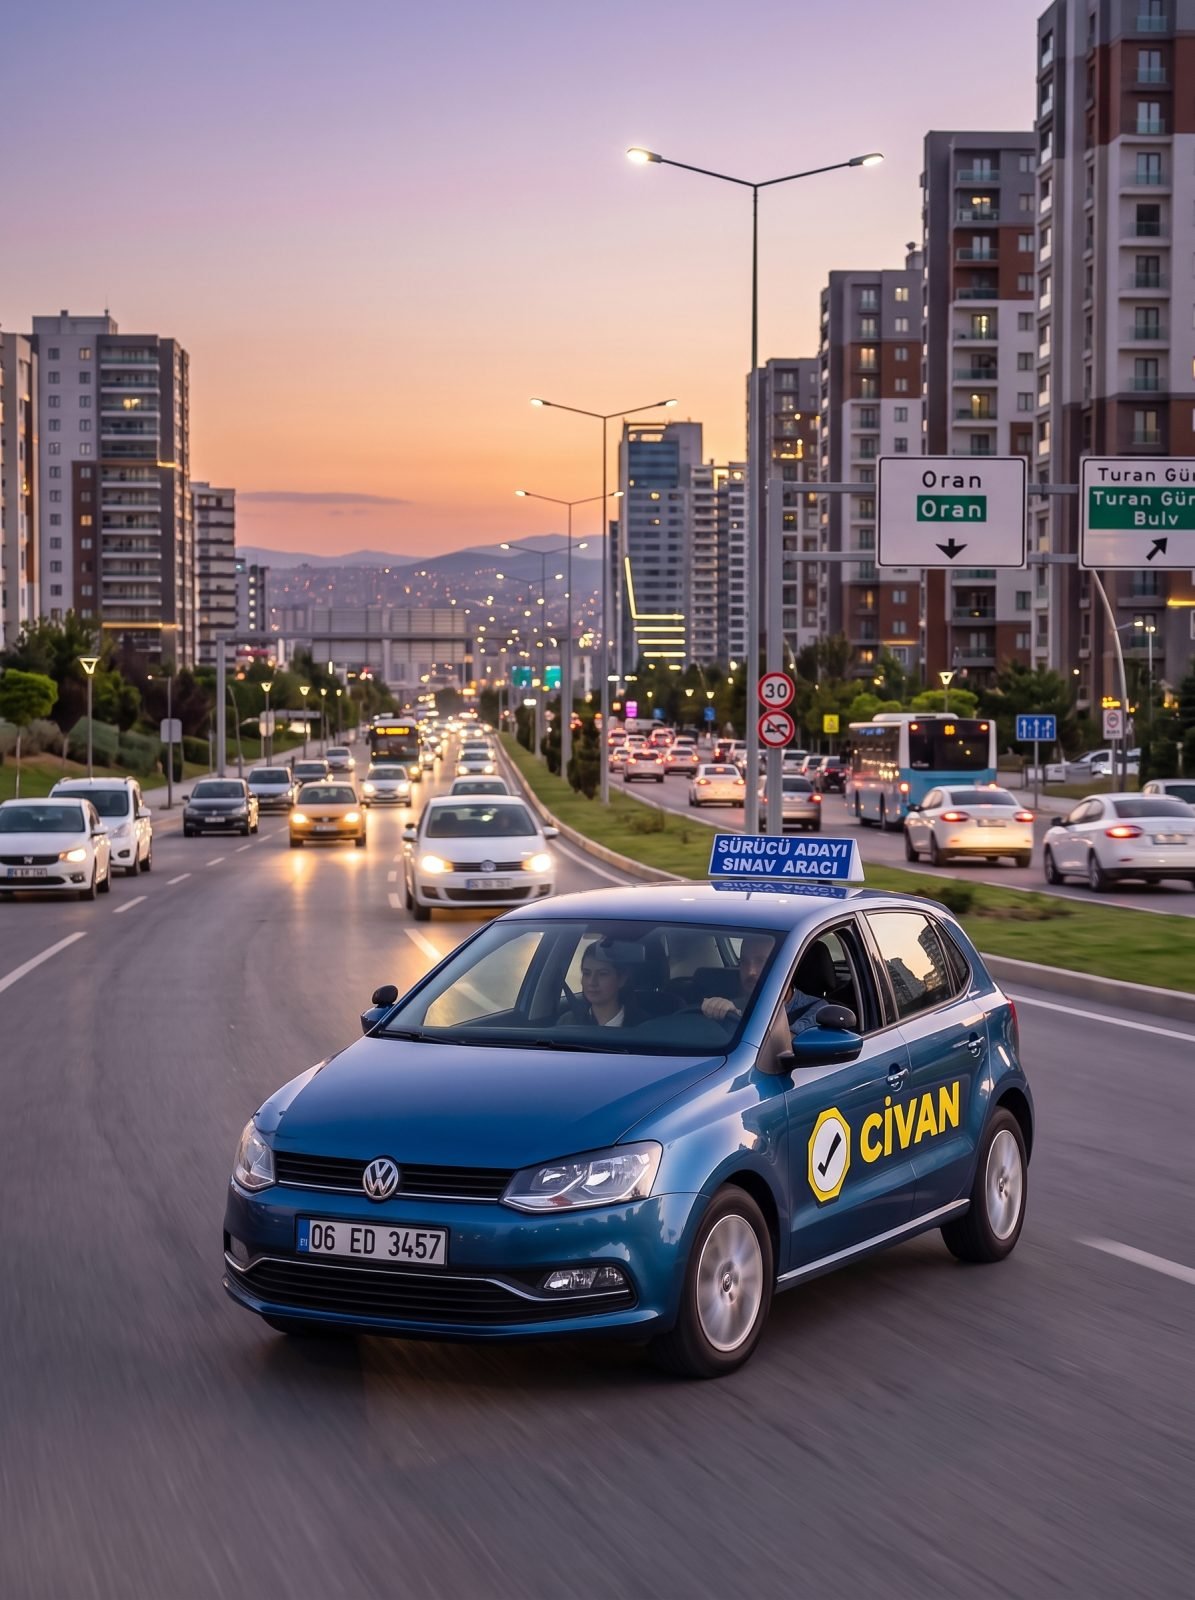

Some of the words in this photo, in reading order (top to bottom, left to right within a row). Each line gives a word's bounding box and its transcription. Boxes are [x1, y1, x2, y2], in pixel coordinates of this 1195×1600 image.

[922, 470, 981, 489] Oran
[1098, 467, 1156, 482] Turan
[1164, 467, 1195, 482] Gü
[1093, 490, 1152, 506] Turan
[921, 500, 981, 518] Oran
[1134, 511, 1178, 526] Bulv
[765, 683, 788, 699] 30
[718, 838, 791, 855] SÜRÜCÜ
[794, 843, 848, 858] ADAYI
[722, 857, 776, 873] SINAV
[782, 860, 837, 875] ARACI
[860, 1081, 960, 1164] CİVAN
[311, 1223, 336, 1251] 06
[350, 1227, 376, 1255] ED
[388, 1231, 442, 1260] 3457
